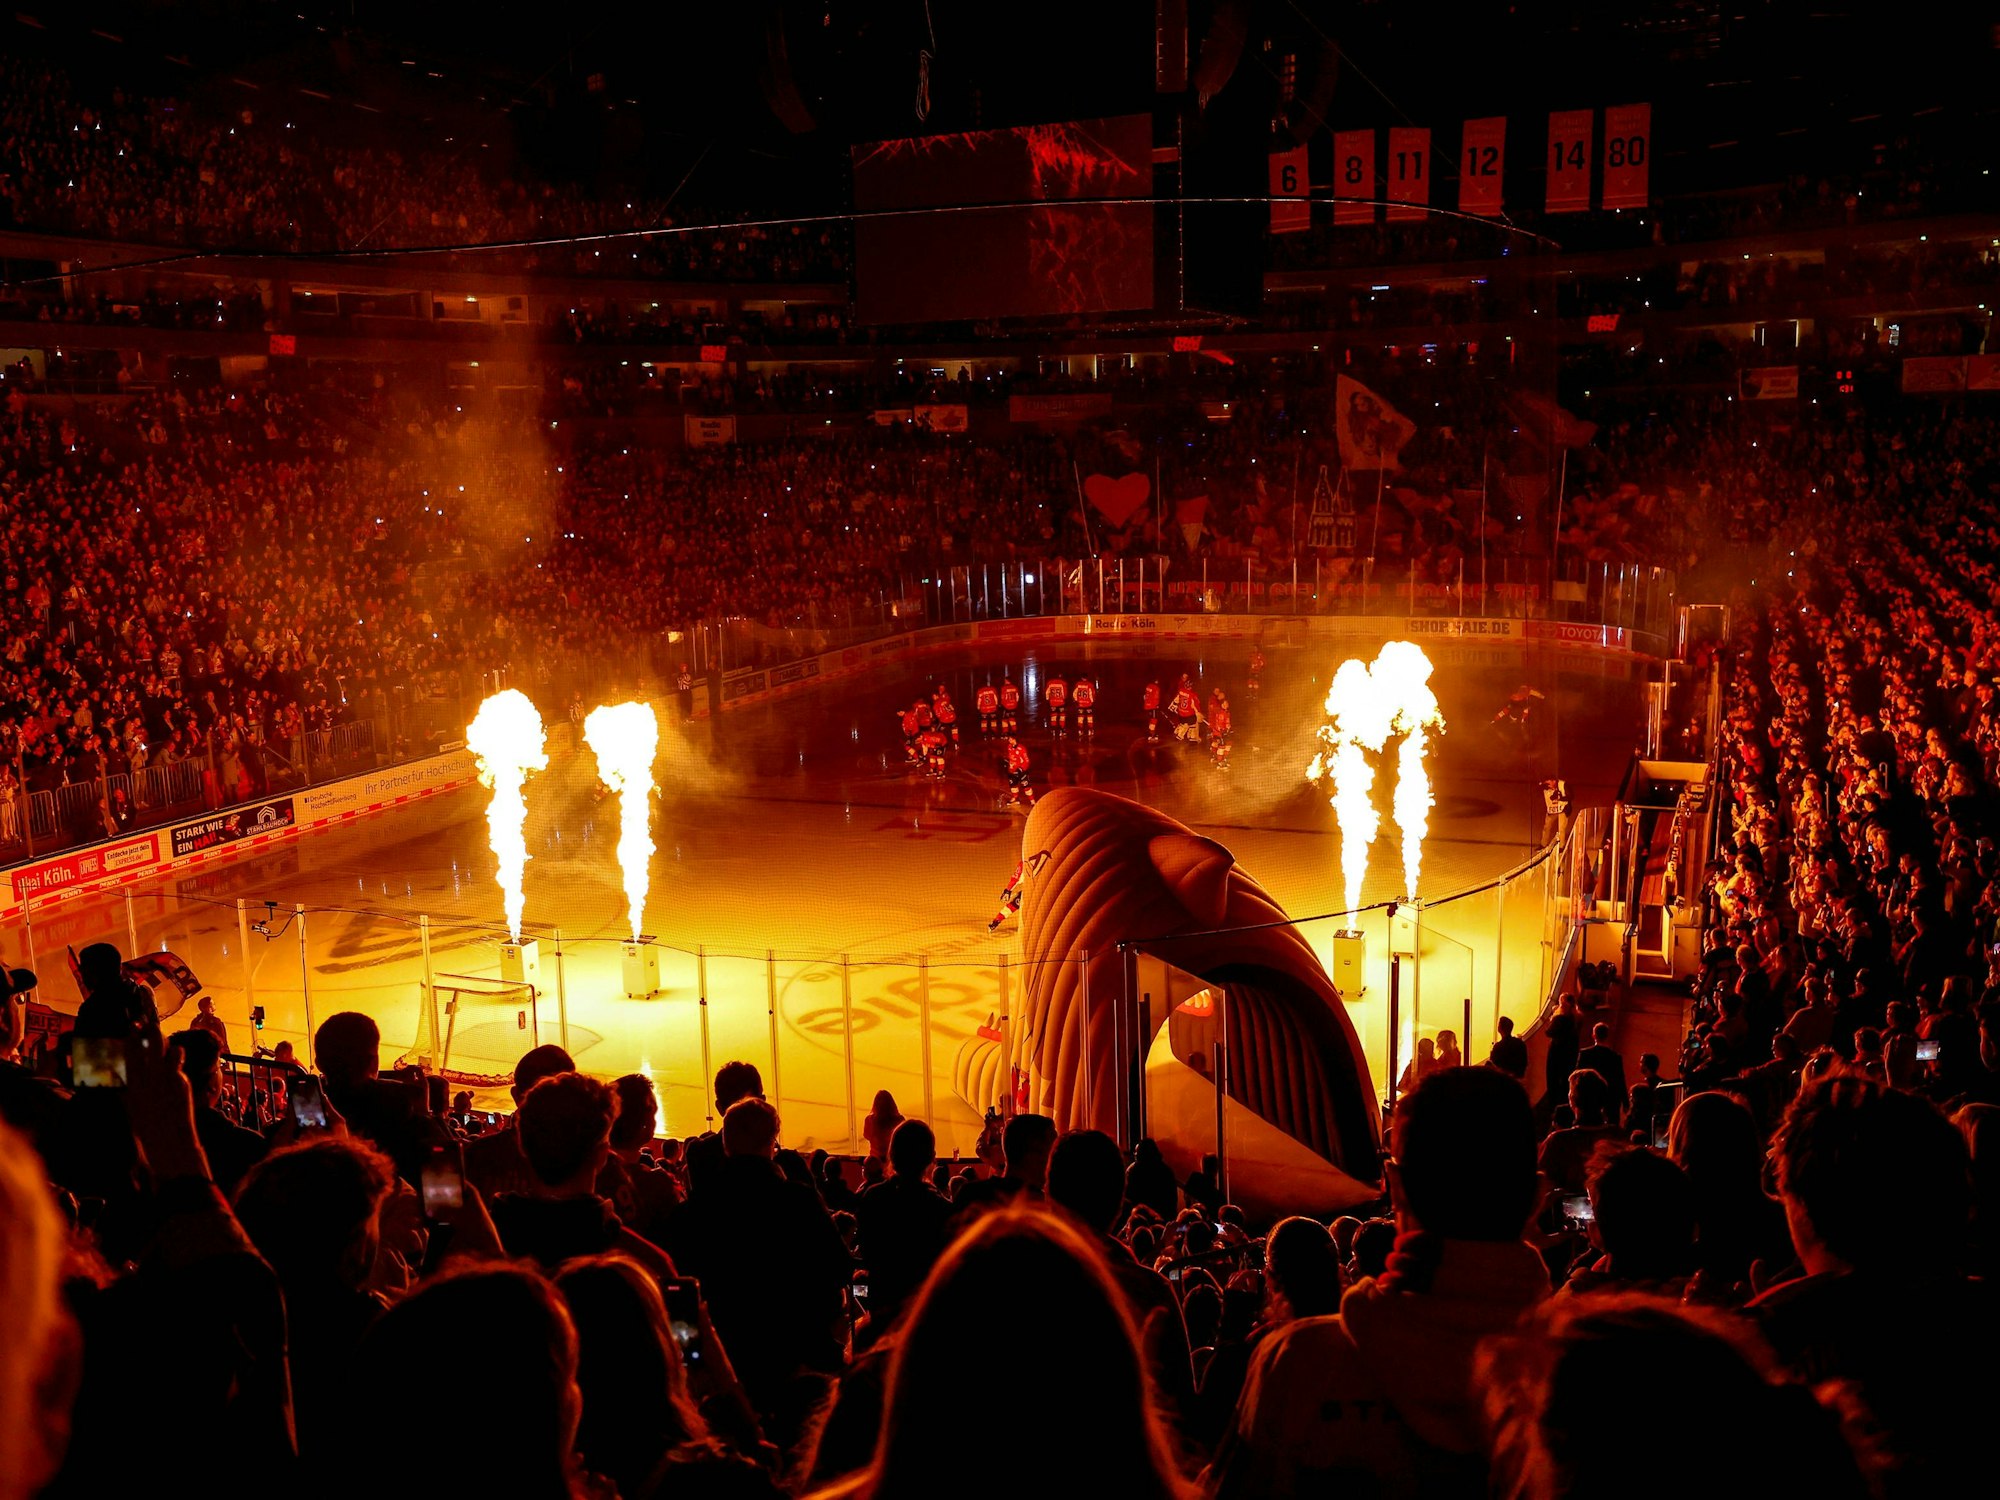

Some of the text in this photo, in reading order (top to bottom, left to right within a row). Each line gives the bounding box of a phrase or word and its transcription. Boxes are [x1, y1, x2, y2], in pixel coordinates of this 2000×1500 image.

[1468, 146, 1499, 176] 12
[1554, 140, 1585, 171] 14
[1609, 136, 1645, 167] 80
[1345, 155, 1363, 184] 8
[1397, 151, 1422, 180] 11
[1281, 165, 1297, 192] 6
[1131, 617, 1156, 629] Köln
[1410, 620, 1511, 635] SHOPAIE.DE
[1560, 626, 1604, 641] TOYOTA
[365, 782, 378, 795] Ihr
[380, 774, 411, 791] Partner
[176, 819, 223, 841] STARK WIE
[177, 831, 217, 853] EIN HAI!
[43, 866, 76, 886] Köln.
[60, 889, 85, 900] PENNY.
